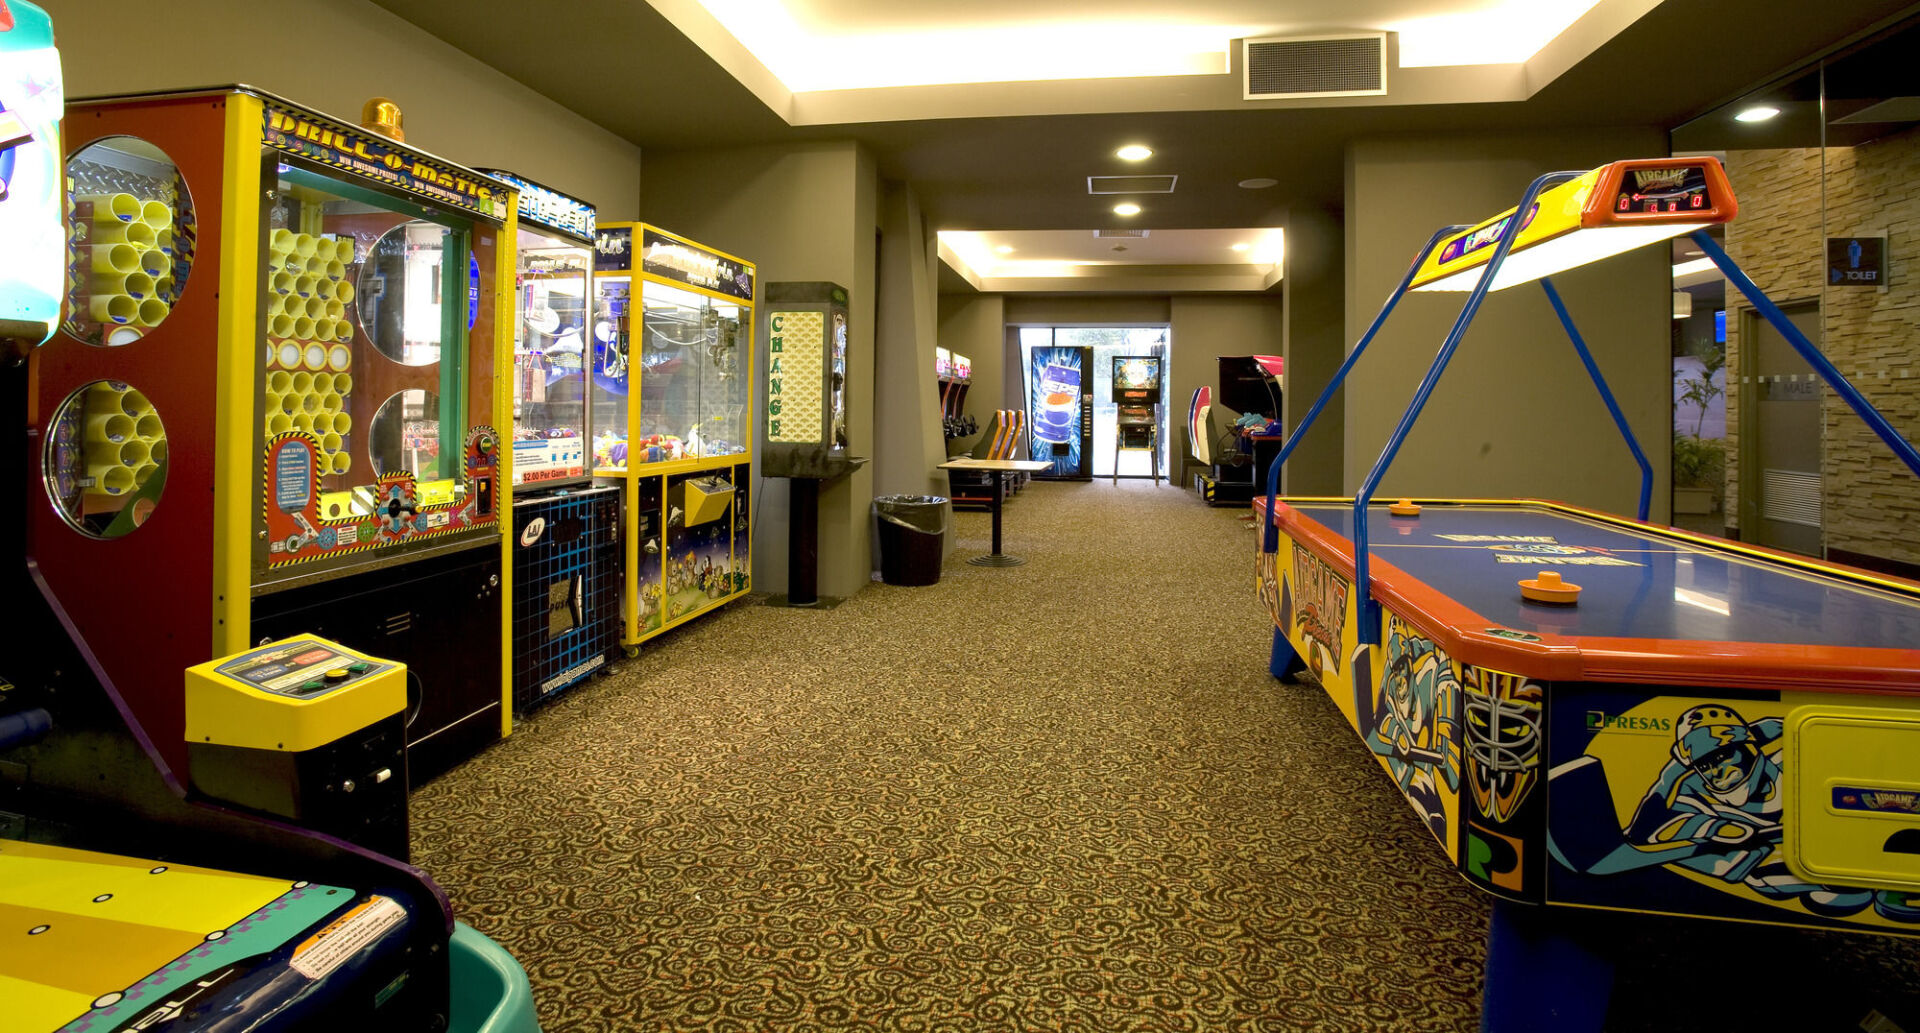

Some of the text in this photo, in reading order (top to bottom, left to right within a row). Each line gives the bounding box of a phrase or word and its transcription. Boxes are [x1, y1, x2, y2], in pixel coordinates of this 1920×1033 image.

[1620, 198, 1629, 210] 0
[1693, 195, 1702, 207] 0
[1846, 271, 1877, 280] TOILET
[769, 316, 784, 437] CHANGE
[1042, 379, 1080, 397] PEPSI
[1783, 382, 1812, 394] MALE
[523, 471, 540, 482] $2.00
[540, 471, 551, 480] Per
[551, 469, 567, 478] Game
[527, 524, 541, 538] LAI
[1604, 715, 1670, 731] PRESAS
